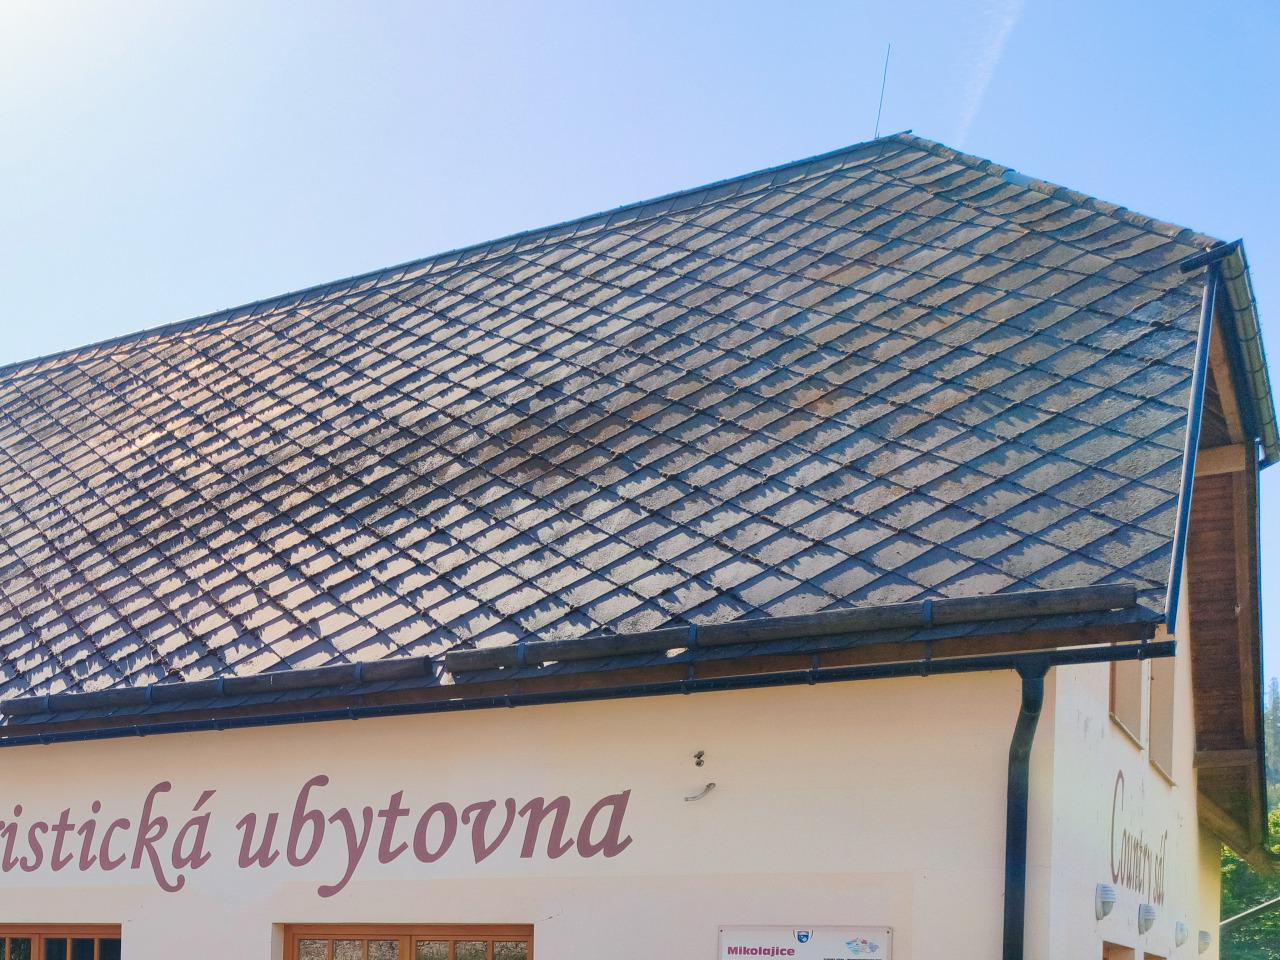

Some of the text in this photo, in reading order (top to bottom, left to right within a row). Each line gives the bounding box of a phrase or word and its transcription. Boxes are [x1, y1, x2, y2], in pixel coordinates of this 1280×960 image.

[236, 774, 632, 898] ubytovna
[1111, 769, 1152, 905] Country
[727, 946, 795, 957] Mikolajice
